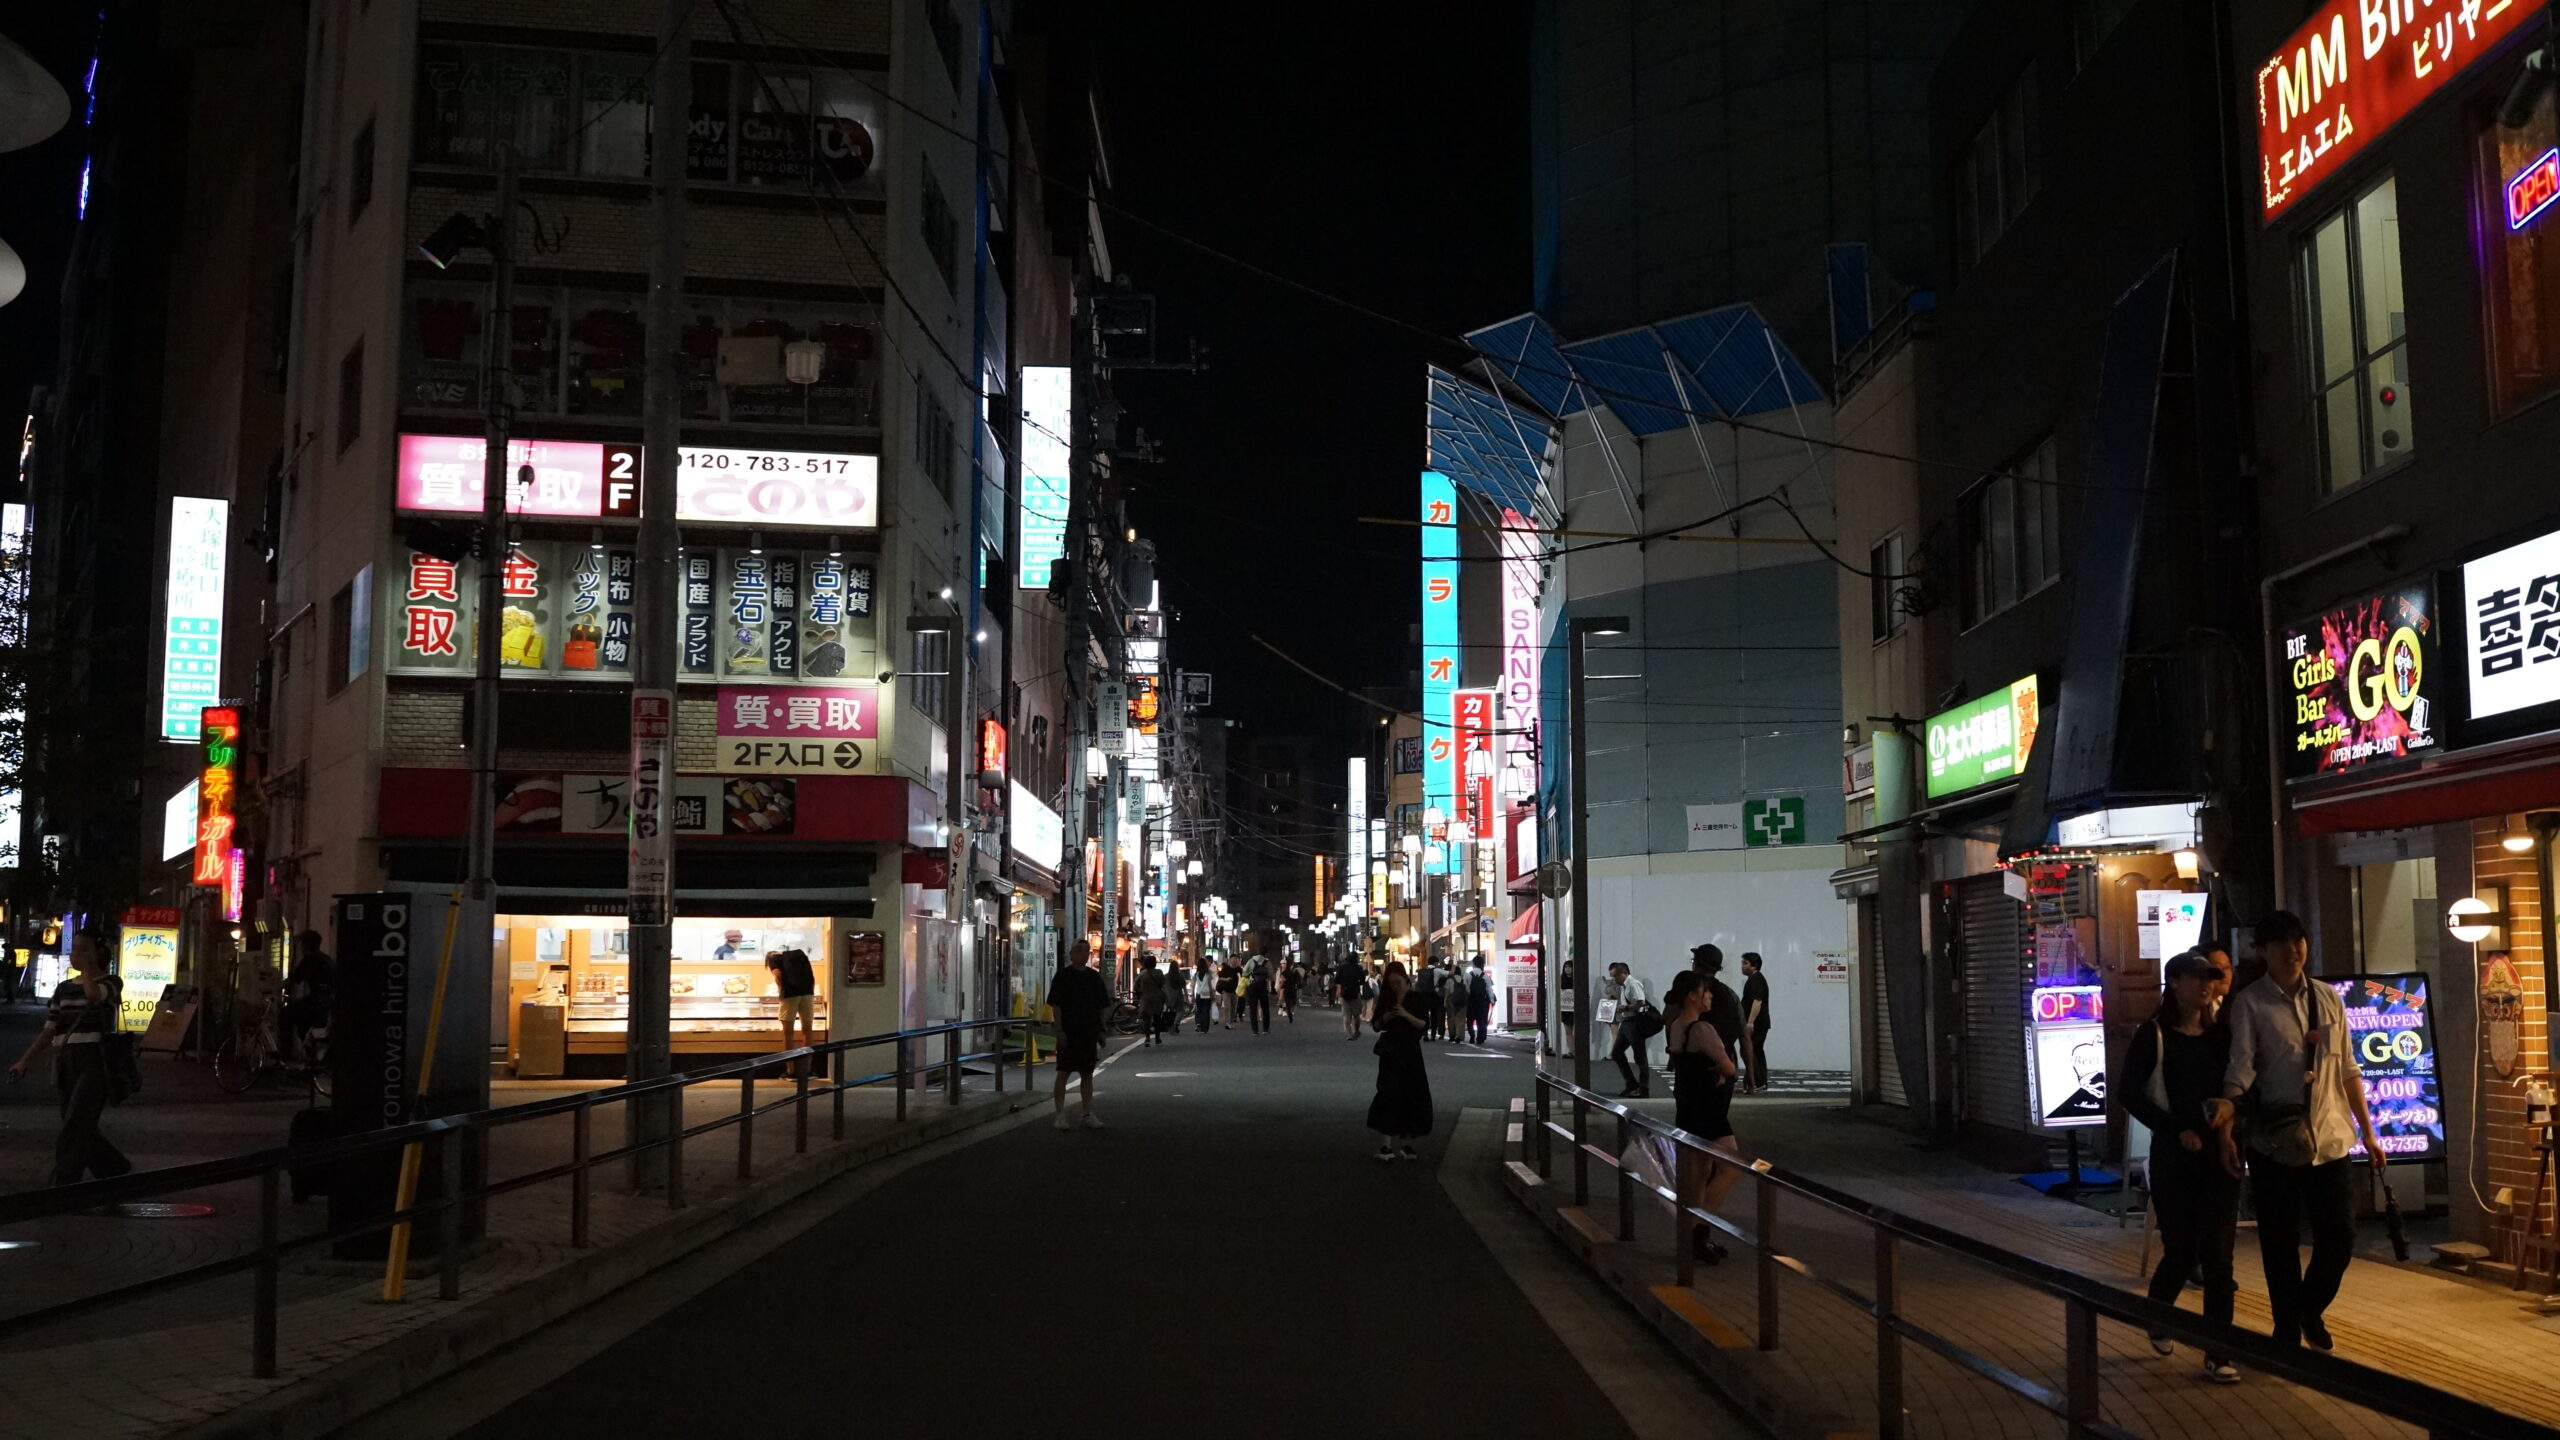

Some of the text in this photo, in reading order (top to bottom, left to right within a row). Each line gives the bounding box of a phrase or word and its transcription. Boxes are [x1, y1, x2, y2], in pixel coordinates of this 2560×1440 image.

[2277, 14, 2348, 133] MM
[2279, 103, 2354, 187] エムエム
[2511, 158, 2559, 220] OPEN
[690, 474, 867, 518] さのや
[199, 505, 223, 593] 大塚北口
[174, 543, 197, 611] 診療所
[609, 556, 633, 602] 財布
[689, 557, 711, 605] 国産
[732, 556, 767, 625] 宝石
[773, 561, 794, 609] 指輪
[811, 558, 843, 626] 古着
[848, 568, 871, 615] 雑貨
[404, 550, 459, 657] 買取
[604, 616, 631, 663] 小物
[685, 615, 709, 667] ブランド
[773, 619, 794, 671] アクセ
[1428, 500, 1453, 763] カラオケ
[2287, 635, 2307, 660] B1F
[1510, 609, 1533, 752] SANOYA
[2293, 648, 2336, 690] Girls
[2348, 626, 2423, 722] GO
[733, 695, 863, 732] 質・買取
[2296, 693, 2327, 725] Bar
[733, 742, 825, 768] 2F入口
[2298, 724, 2352, 752] ガールズバー
[2330, 748, 2351, 764] OPEN
[633, 758, 660, 840] さのや
[2037, 992, 2103, 1019] OPN
[2361, 1030, 2423, 1063] GO
